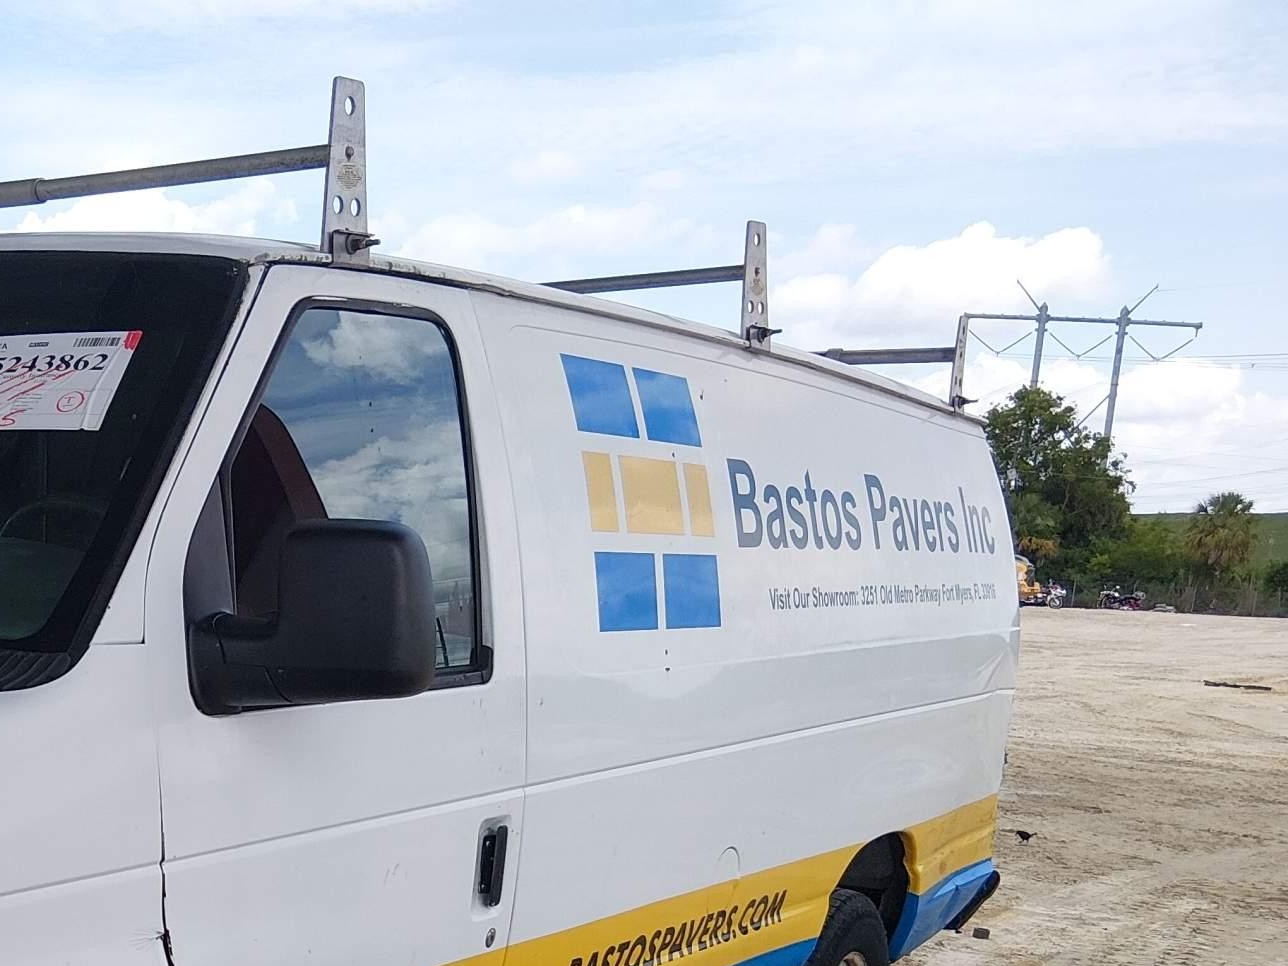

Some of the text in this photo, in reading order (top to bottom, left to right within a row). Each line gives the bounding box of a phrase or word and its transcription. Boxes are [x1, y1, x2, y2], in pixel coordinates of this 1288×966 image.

[727, 458, 996, 555] Bastos Pavers Inc
[769, 587, 791, 610] Visit
[793, 587, 810, 609] Our
[811, 586, 859, 608] Showroom:
[861, 584, 878, 606] 3251
[880, 584, 893, 605] Old
[894, 584, 914, 604] Metro
[914, 584, 941, 606] Parkway
[942, 583, 955, 602] Fort
